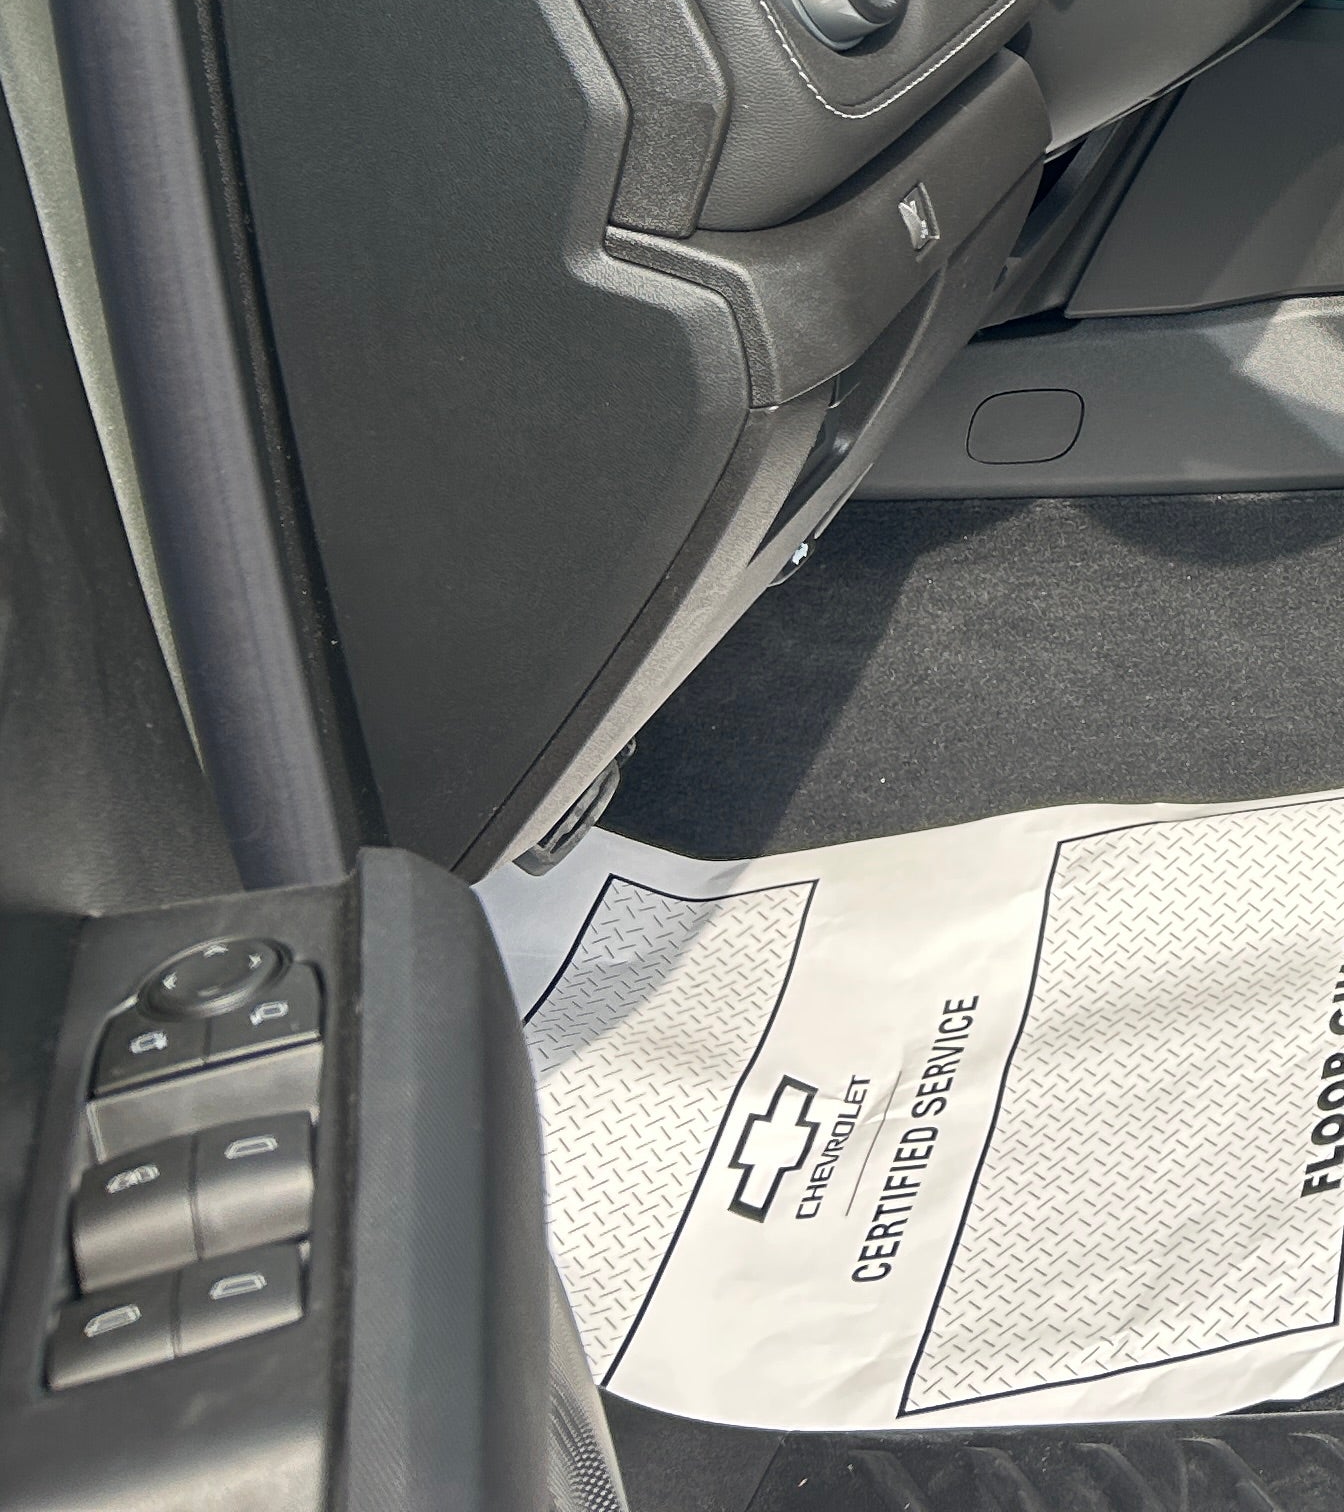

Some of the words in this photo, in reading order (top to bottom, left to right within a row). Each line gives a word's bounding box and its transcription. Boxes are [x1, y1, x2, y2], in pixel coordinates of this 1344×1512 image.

[794, 1074, 871, 1220] CHEVROLET
[851, 1126, 940, 1283] CERTIFIED
[911, 995, 980, 1119] SERVICE
